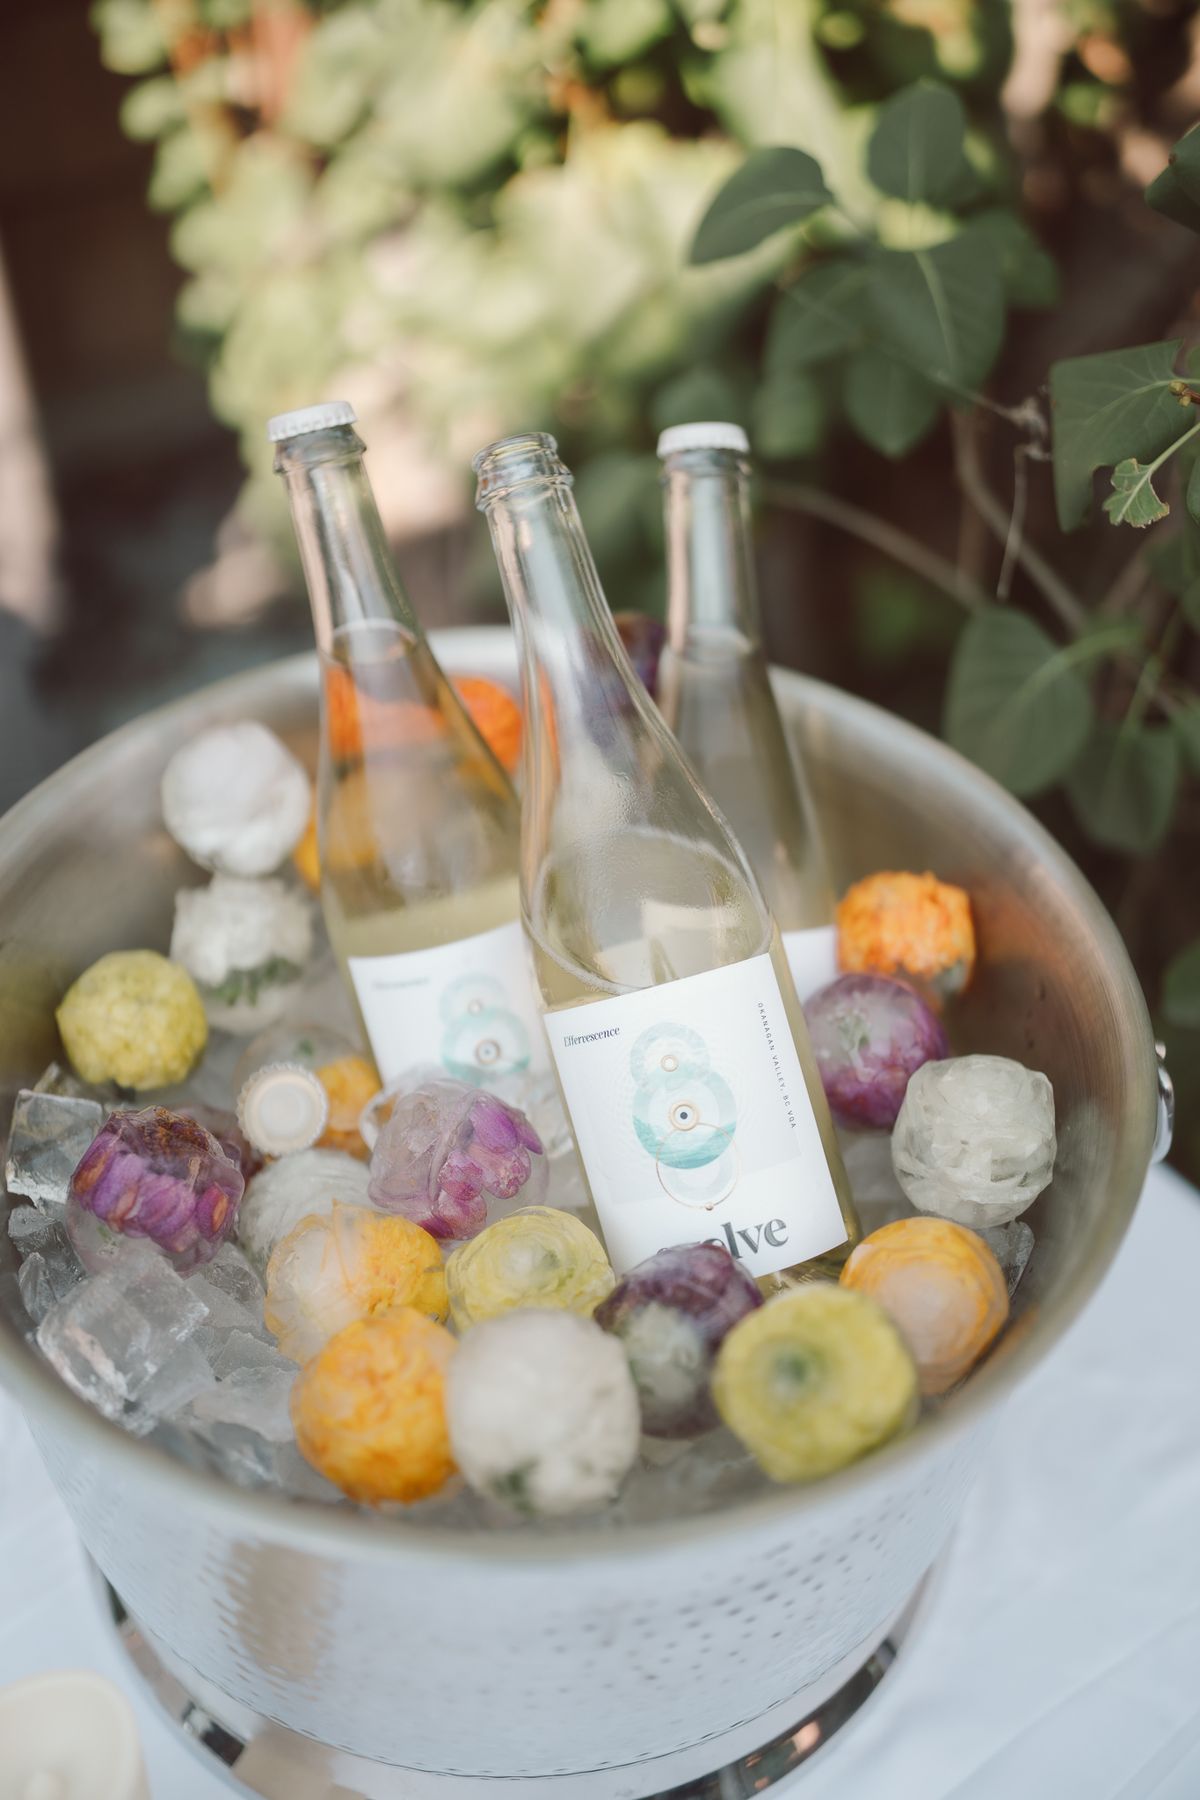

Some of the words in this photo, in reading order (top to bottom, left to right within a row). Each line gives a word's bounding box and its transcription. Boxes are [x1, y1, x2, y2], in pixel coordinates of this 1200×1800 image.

[563, 1027, 620, 1047] Effervescence
[758, 1002, 774, 1050] OKANAGAN
[782, 1095, 791, 1107] BC
[787, 1110, 797, 1128] VQA
[657, 1218, 789, 1260] lve
